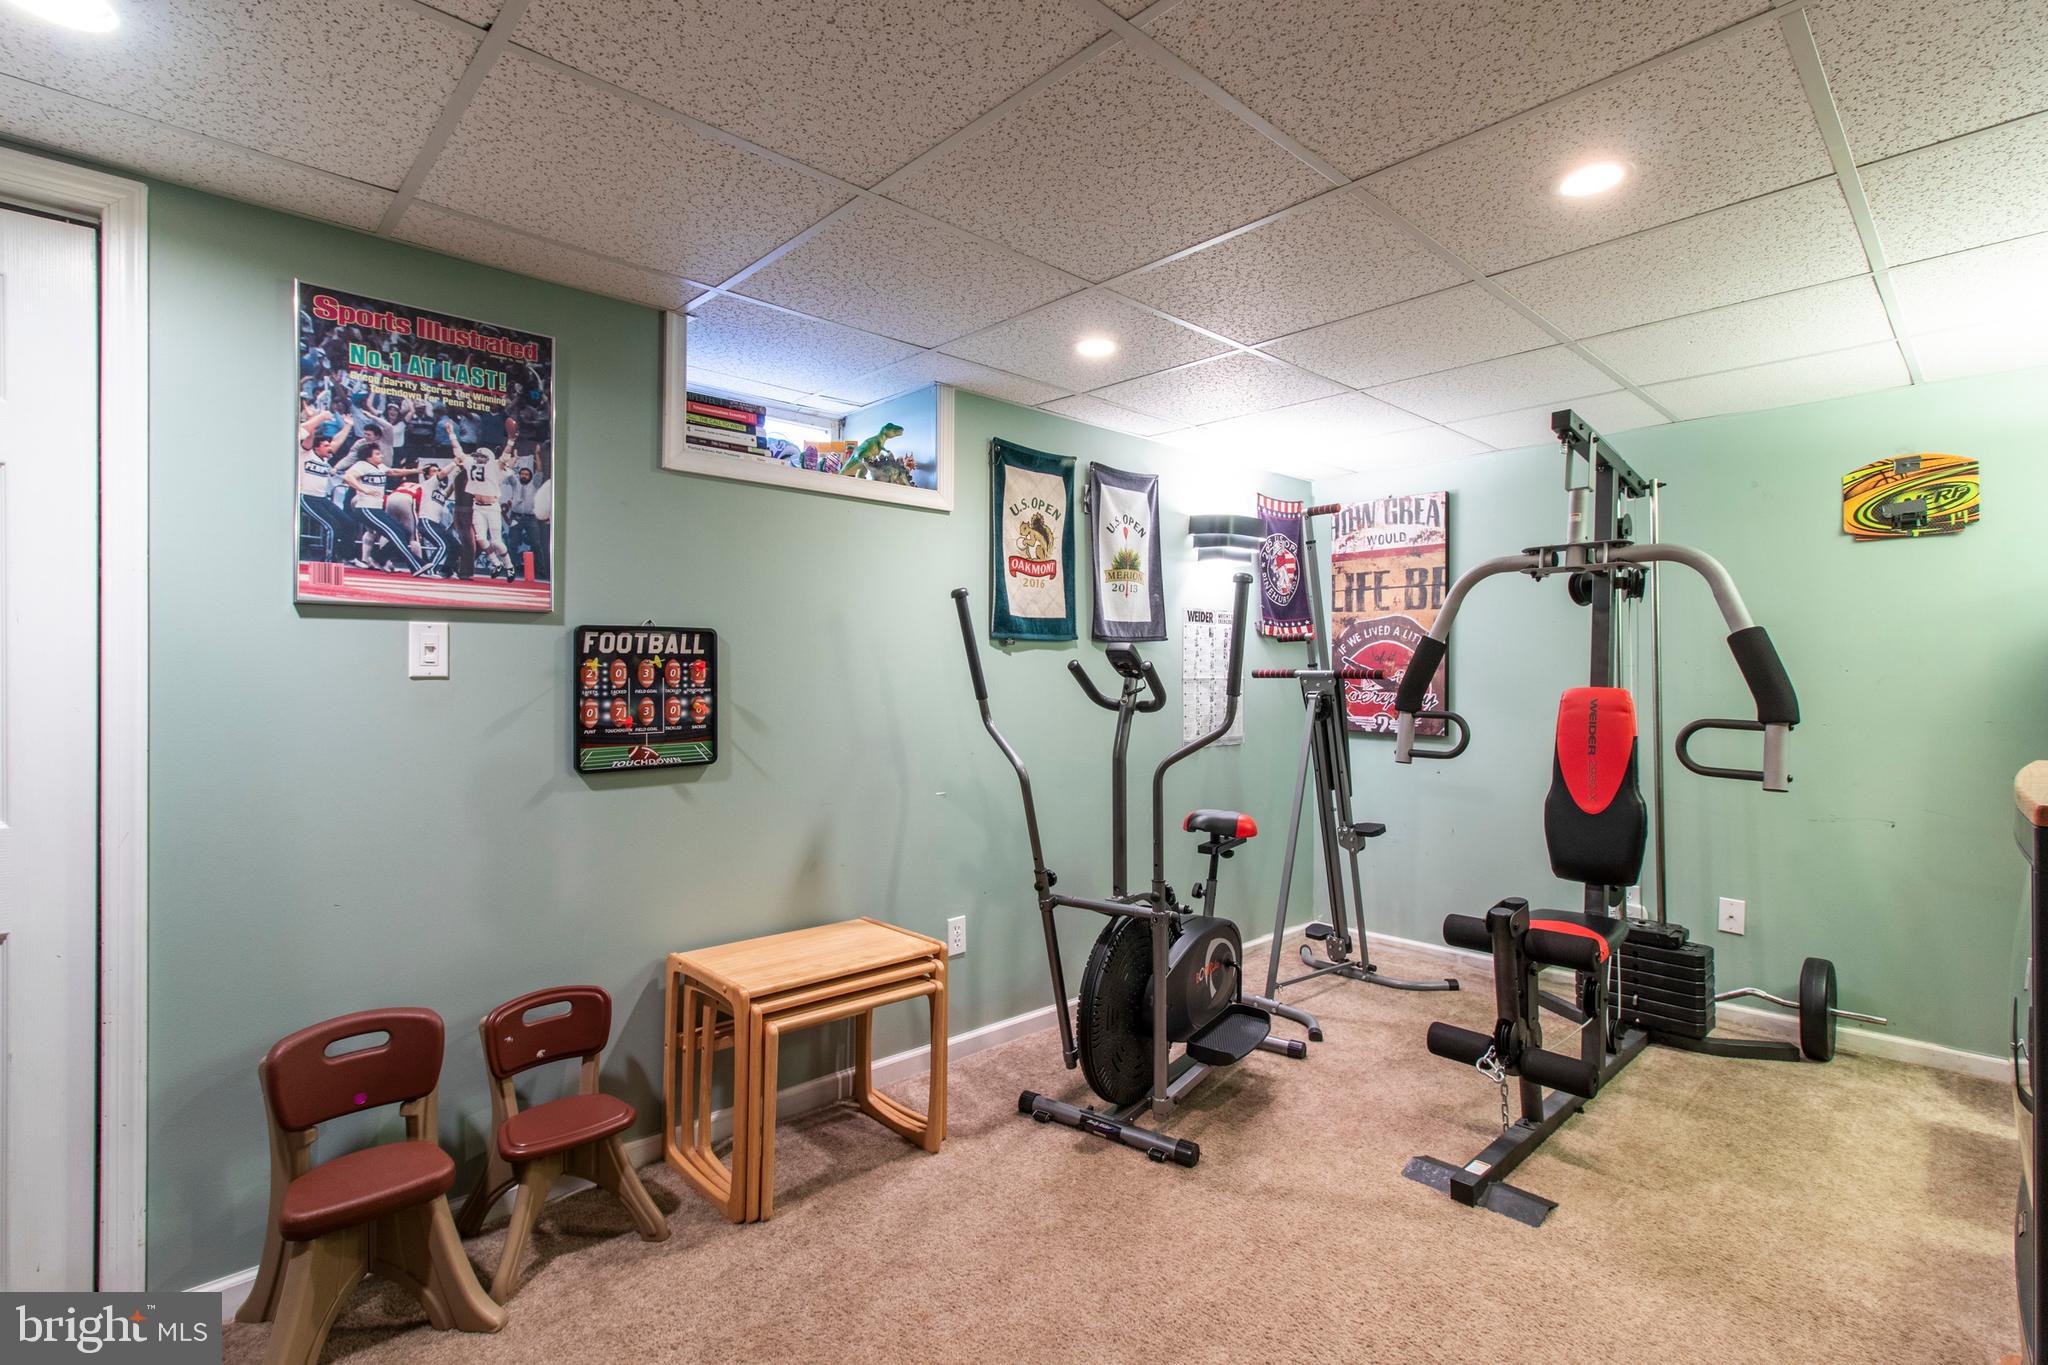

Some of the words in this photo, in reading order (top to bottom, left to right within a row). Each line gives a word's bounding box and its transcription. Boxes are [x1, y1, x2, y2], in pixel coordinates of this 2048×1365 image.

[313, 294, 412, 335] Sports
[417, 316, 538, 362] Illustrated
[408, 354, 435, 378] AT
[442, 360, 506, 392] LAST!
[370, 384, 422, 400] Touchdown
[424, 394, 439, 403] For
[443, 397, 464, 407] Penn
[467, 400, 490, 412] State
[383, 377, 417, 390] Garrity
[420, 382, 452, 396] Scores
[455, 388, 470, 399] The
[473, 392, 506, 406] Winning
[1010, 498, 1030, 516] U.S.
[1032, 498, 1062, 520] OPEN
[1123, 514, 1146, 538] OPEN
[1367, 532, 1406, 546] WOULD
[1012, 558, 1055, 575] OAKMONT
[1108, 570, 1144, 582] MERION
[1024, 578, 1045, 588] 2016
[1332, 570, 1390, 612] LIFE
[1187, 610, 1214, 624] WEIDER
[583, 632, 704, 654] FOOTBALL
[1338, 644, 1347, 655] IF
[1347, 632, 1362, 647] WE
[1364, 626, 1390, 638] LIVED
[1392, 626, 1400, 636] A
[616, 670, 622, 678] 0
[586, 709, 593, 717] 0
[1588, 699, 1598, 755] WEIDER
[612, 757, 682, 768] TOUCHDOWN
[644, 751, 650, 759] 7
